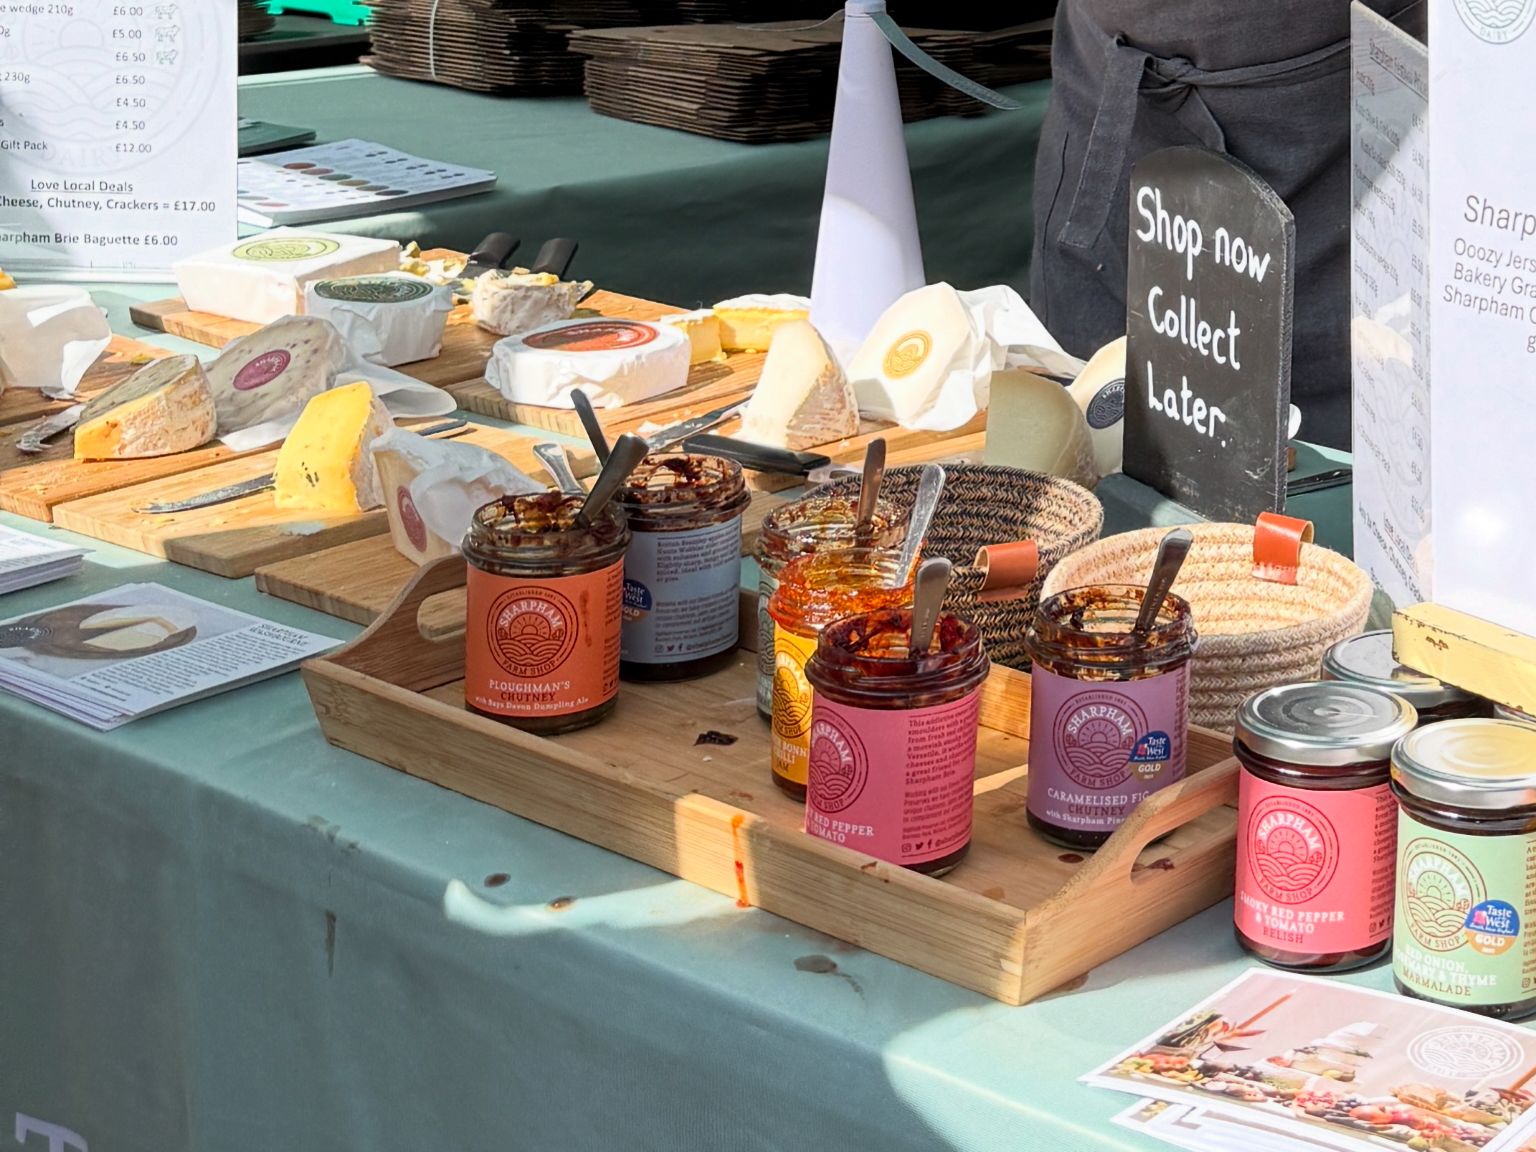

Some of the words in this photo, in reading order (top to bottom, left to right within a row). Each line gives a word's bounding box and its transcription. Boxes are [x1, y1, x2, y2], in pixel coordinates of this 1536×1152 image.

[48, 5, 74, 17] 210g
[4, 71, 31, 84] 230g
[24, 140, 48, 150] Pack
[115, 143, 152, 153] £12.00
[31, 179, 60, 191] Love
[64, 180, 95, 191] Local
[100, 181, 134, 192] Deals
[47, 197, 103, 211] Chutney,
[106, 198, 159, 210] Crackers
[174, 201, 216, 212] £17.00
[54, 232, 80, 244] Brie
[84, 233, 140, 247] Baguette
[144, 235, 178, 246] £6.00
[1136, 185, 1202, 281] Shop
[1214, 226, 1271, 284] now
[1454, 237, 1503, 268] Ooozy
[1453, 263, 1507, 295] Bakery
[1442, 285, 1524, 322] Sharpham
[1147, 285, 1241, 371] Collect
[499, 600, 563, 628] SHARPHAM
[501, 659, 528, 675] FARM
[529, 660, 556, 675] SHOP
[489, 679, 571, 693] PLOUGHMAN'S
[500, 692, 556, 703] CHUTNEY
[1067, 705, 1133, 736] SHARPHAM
[1147, 736, 1167, 746] Taste
[1146, 747, 1165, 756] West
[1137, 763, 1161, 773] GOLD
[1069, 768, 1097, 786] FARM
[1100, 770, 1127, 786] SHOP
[1047, 787, 1128, 805] CARAMELISED
[1067, 804, 1126, 816] CHUTNEY
[831, 818, 875, 837] PEPPER
[1257, 812, 1322, 850] SHARPHAM
[1270, 904, 1295, 920] RED
[1297, 910, 1345, 923] PEPPER
[1486, 904, 1512, 918] Taste
[1264, 914, 1315, 934] TOMATO
[1484, 917, 1511, 929] West
[1262, 926, 1305, 945] RELISH
[1475, 935, 1506, 947] GOLD
[1402, 967, 1472, 997] MARMALADE
[1450, 972, 1498, 987] THYME
